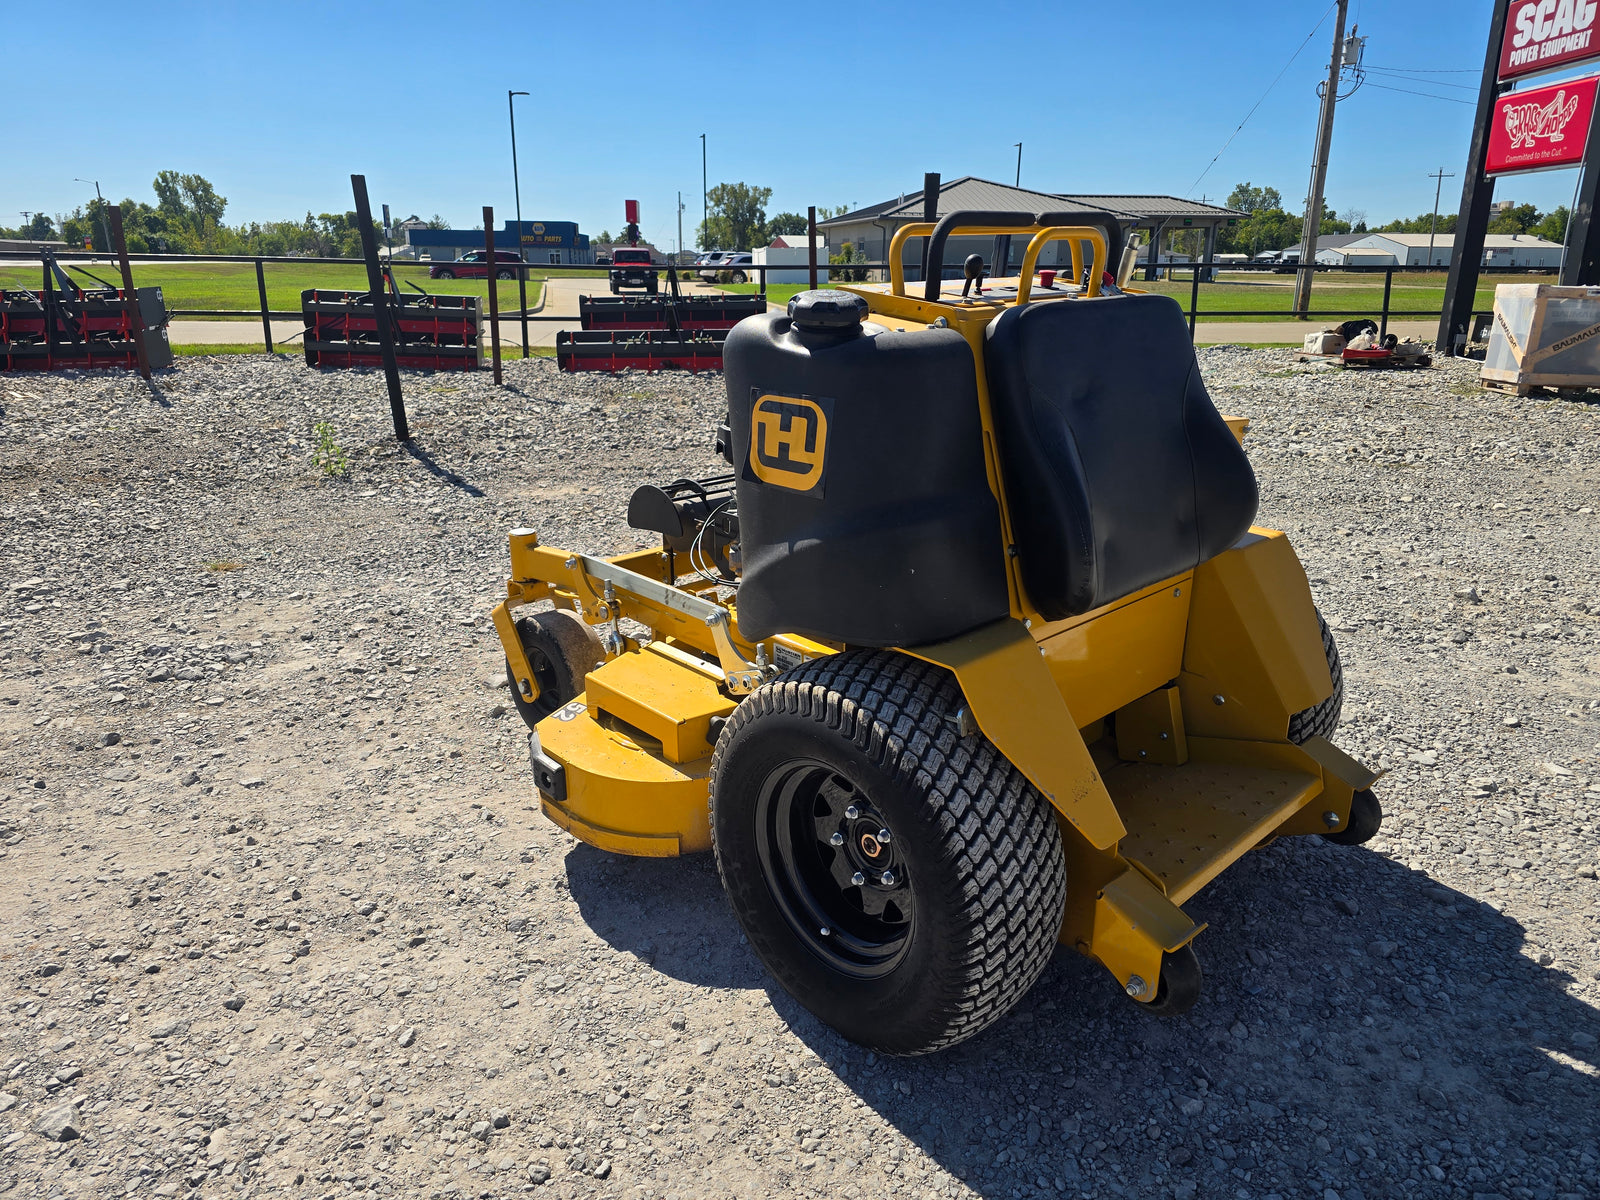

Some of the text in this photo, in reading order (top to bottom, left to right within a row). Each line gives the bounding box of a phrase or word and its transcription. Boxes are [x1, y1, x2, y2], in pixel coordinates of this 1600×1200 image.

[1509, 29, 1593, 68] POWER EQUIPMENT
[1505, 152, 1534, 163] Committed
[1535, 151, 1541, 159] to
[1541, 150, 1550, 158] the
[550, 702, 588, 722] 52
